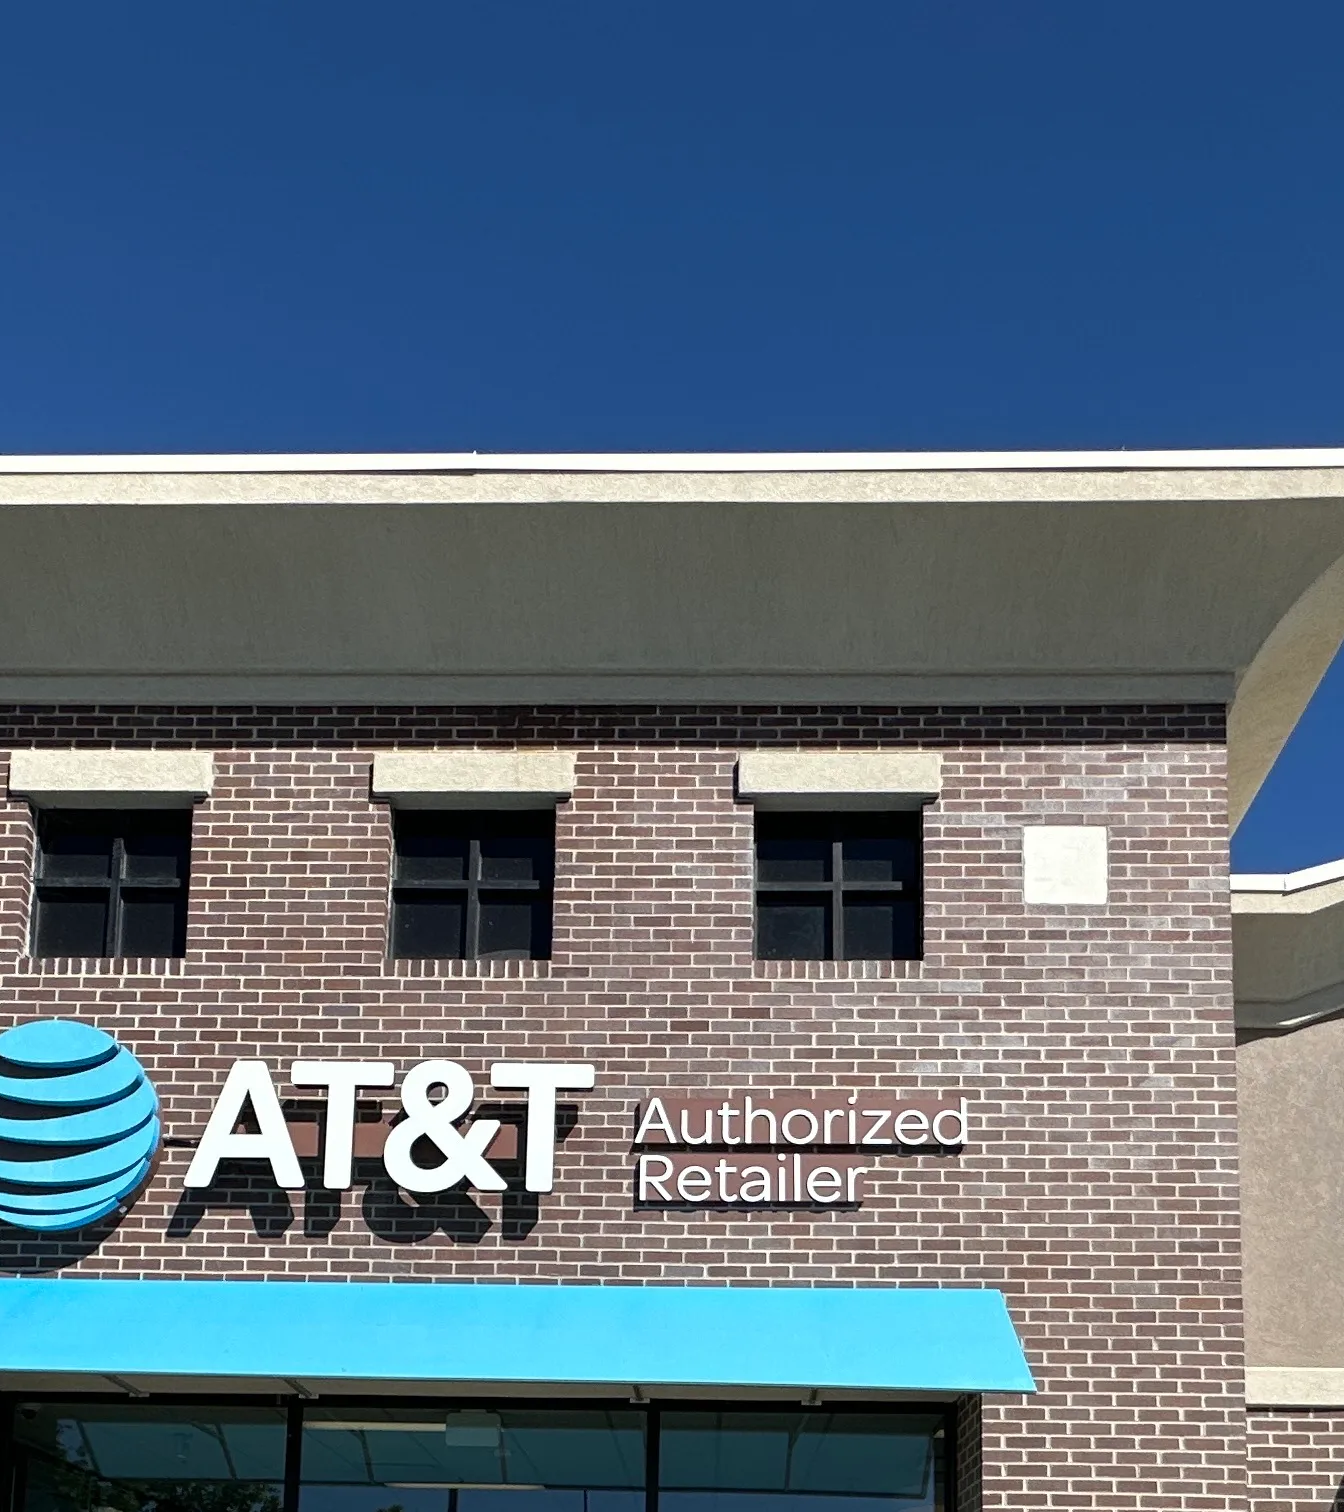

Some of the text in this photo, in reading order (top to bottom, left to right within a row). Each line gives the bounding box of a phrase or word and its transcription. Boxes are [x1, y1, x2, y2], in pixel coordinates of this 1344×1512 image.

[182, 1059, 596, 1194] AT&T
[634, 1096, 969, 1146] Authorized
[638, 1153, 869, 1203] Retailer
